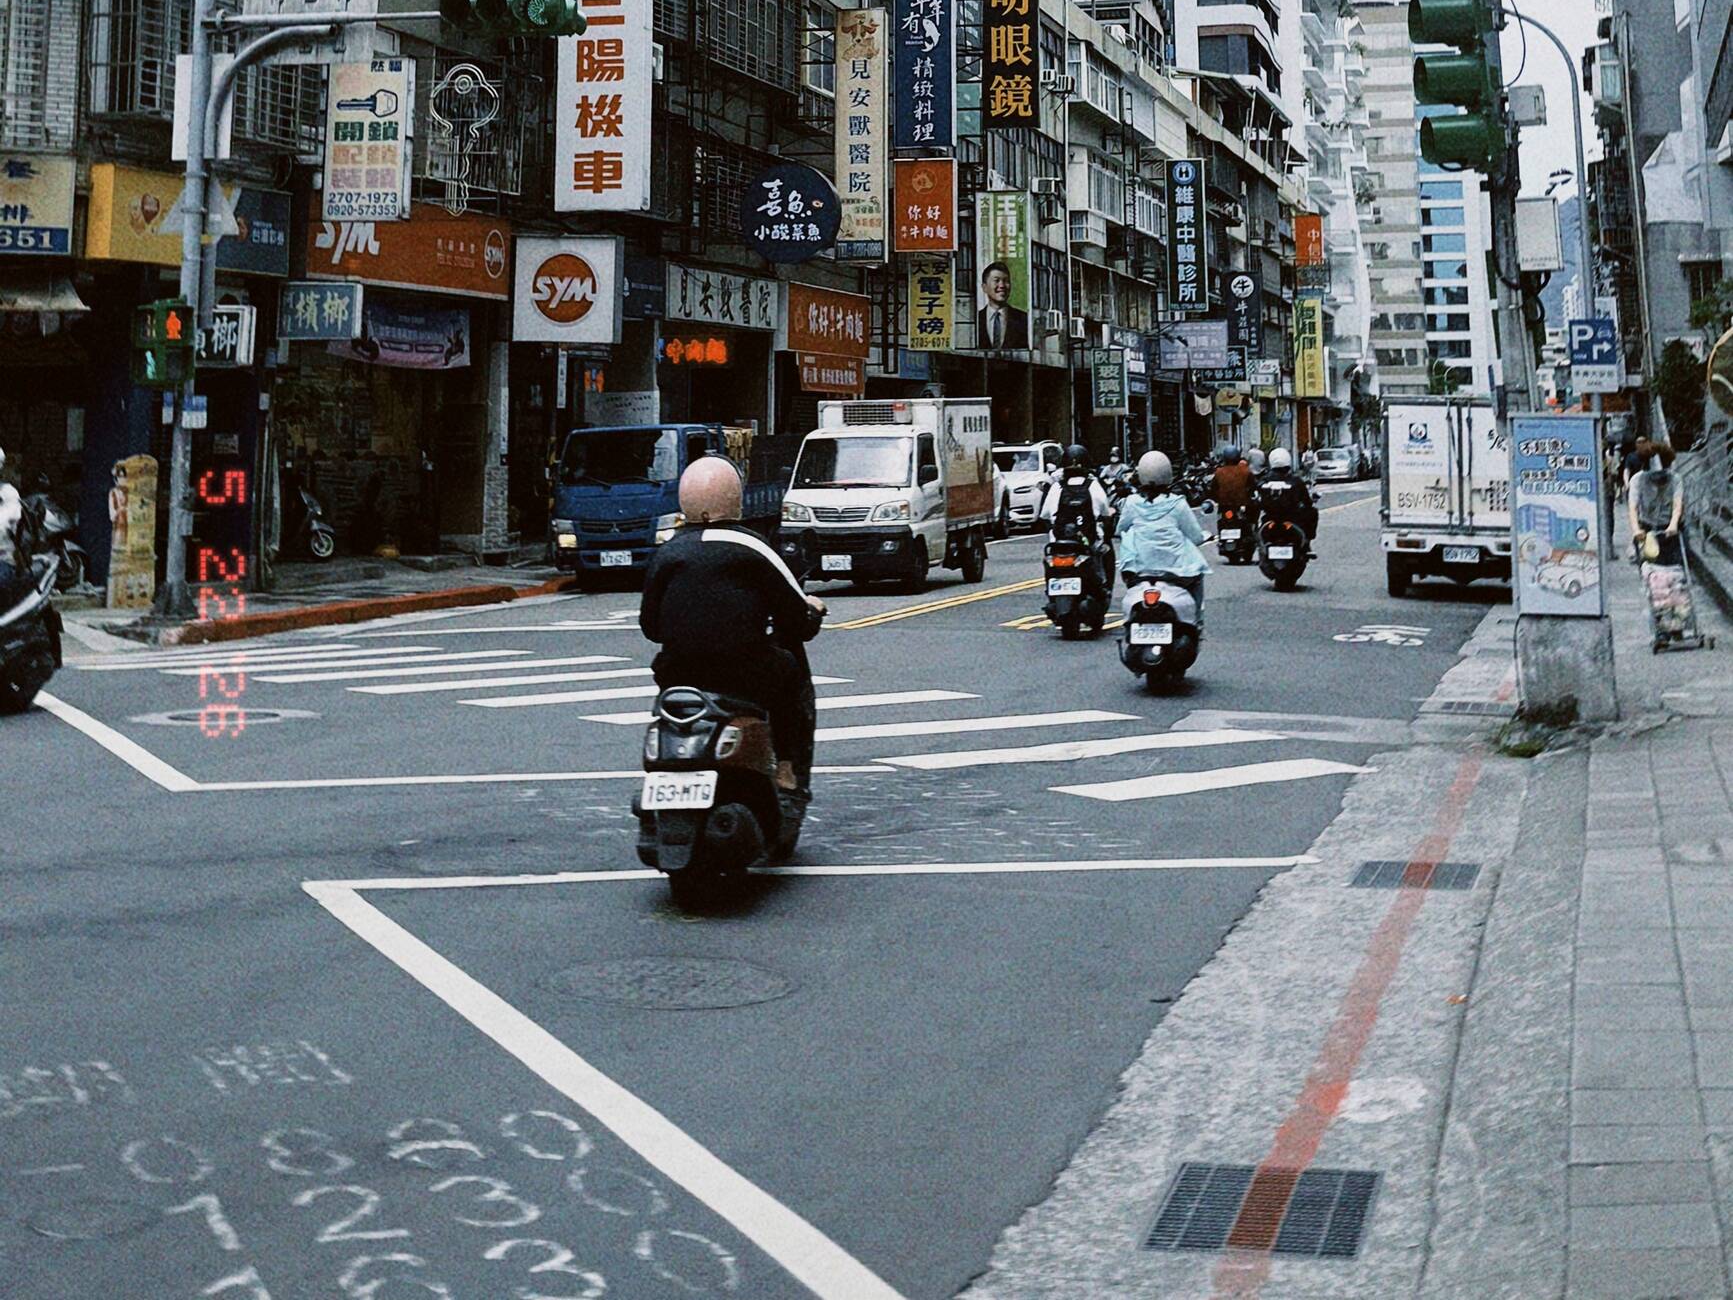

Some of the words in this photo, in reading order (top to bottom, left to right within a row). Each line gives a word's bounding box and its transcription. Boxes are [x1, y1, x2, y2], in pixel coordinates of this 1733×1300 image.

[912, 56, 936, 142] 精緻料理
[333, 120, 399, 142] 開鎖
[847, 58, 872, 194] 見安獸醫院
[326, 204, 398, 217] 0920-573353
[328, 192, 398, 204] 2707-1973
[907, 204, 942, 222] 你好
[754, 222, 822, 242] 小酸菜魚
[909, 224, 949, 241] 牛肉麵
[1173, 185, 1198, 303] 維康中醫診所
[911, 260, 950, 276] 大安
[531, 275, 598, 309] SYM
[295, 288, 351, 333] 檳榔
[808, 301, 829, 338] 你好
[915, 276, 946, 336] 電子磅
[1571, 324, 1594, 351] P
[1098, 365, 1121, 407] 玻璃行
[1397, 491, 1446, 511] BSV-1752
